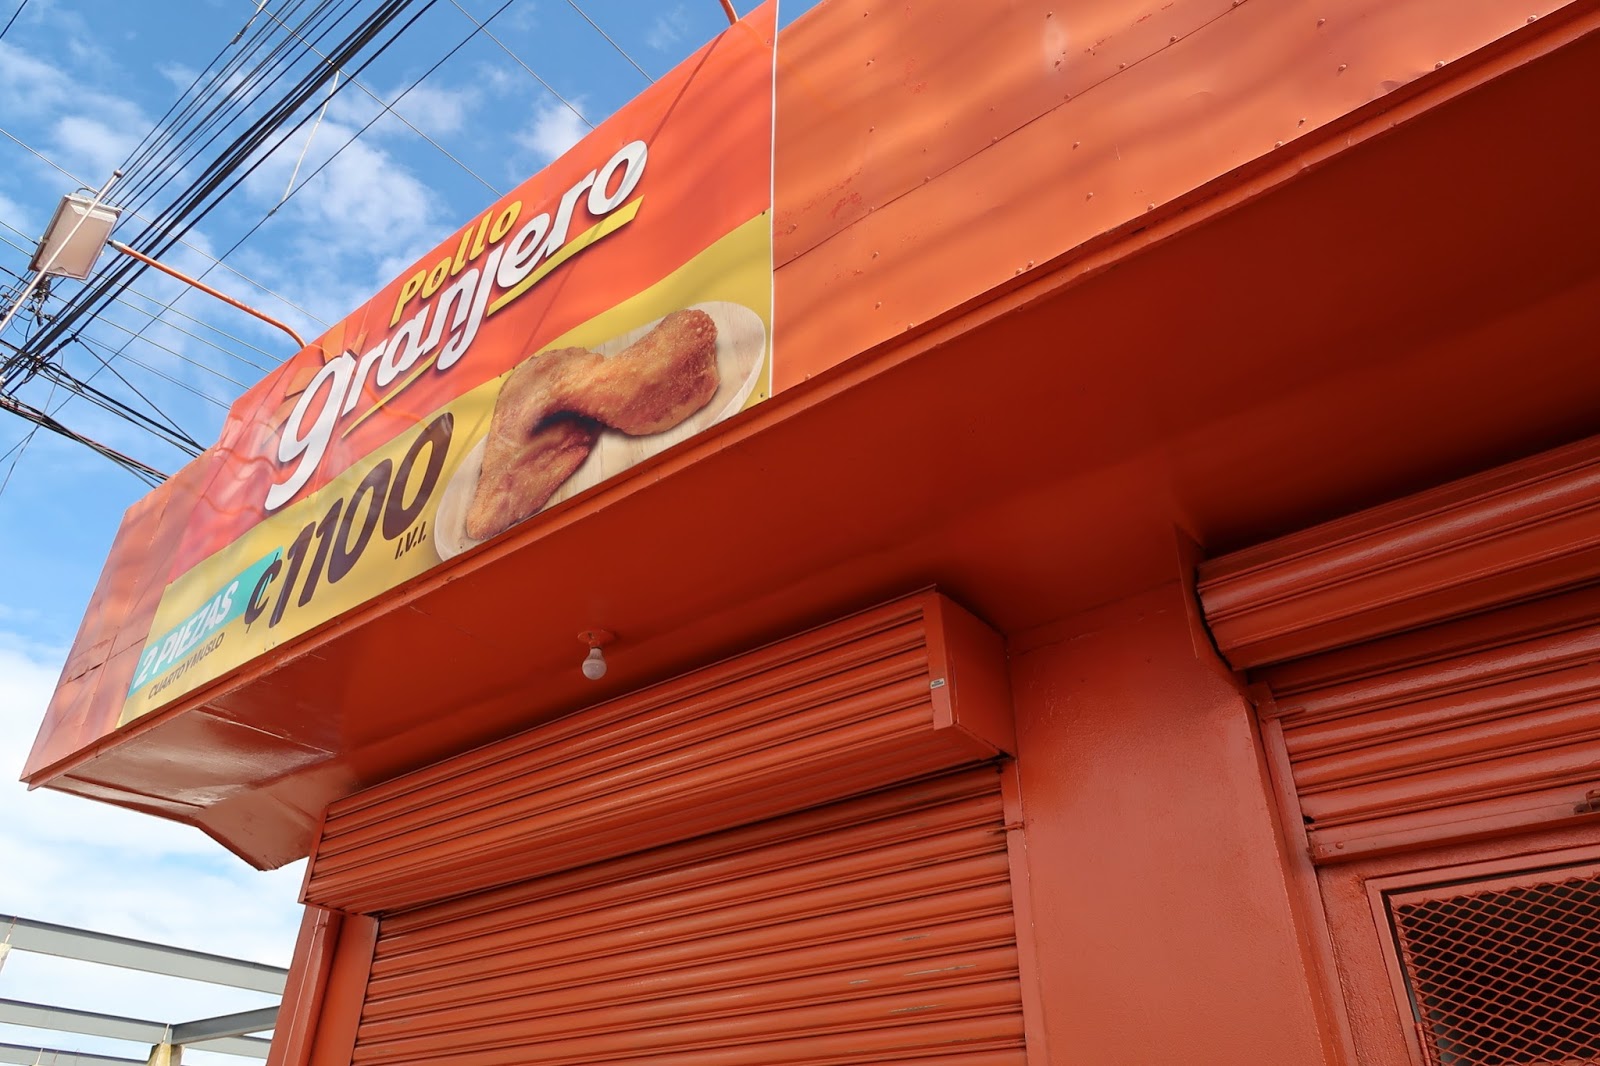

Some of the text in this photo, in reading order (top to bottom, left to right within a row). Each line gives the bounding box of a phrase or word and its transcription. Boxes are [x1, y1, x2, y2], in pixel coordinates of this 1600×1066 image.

[389, 200, 522, 328] Pollo
[264, 140, 648, 511] granjero
[394, 520, 427, 560] I.V.I.
[133, 580, 239, 689] 2 PIEZAS
[148, 663, 186, 699] CUARTO
[190, 632, 225, 668] MUSLO
